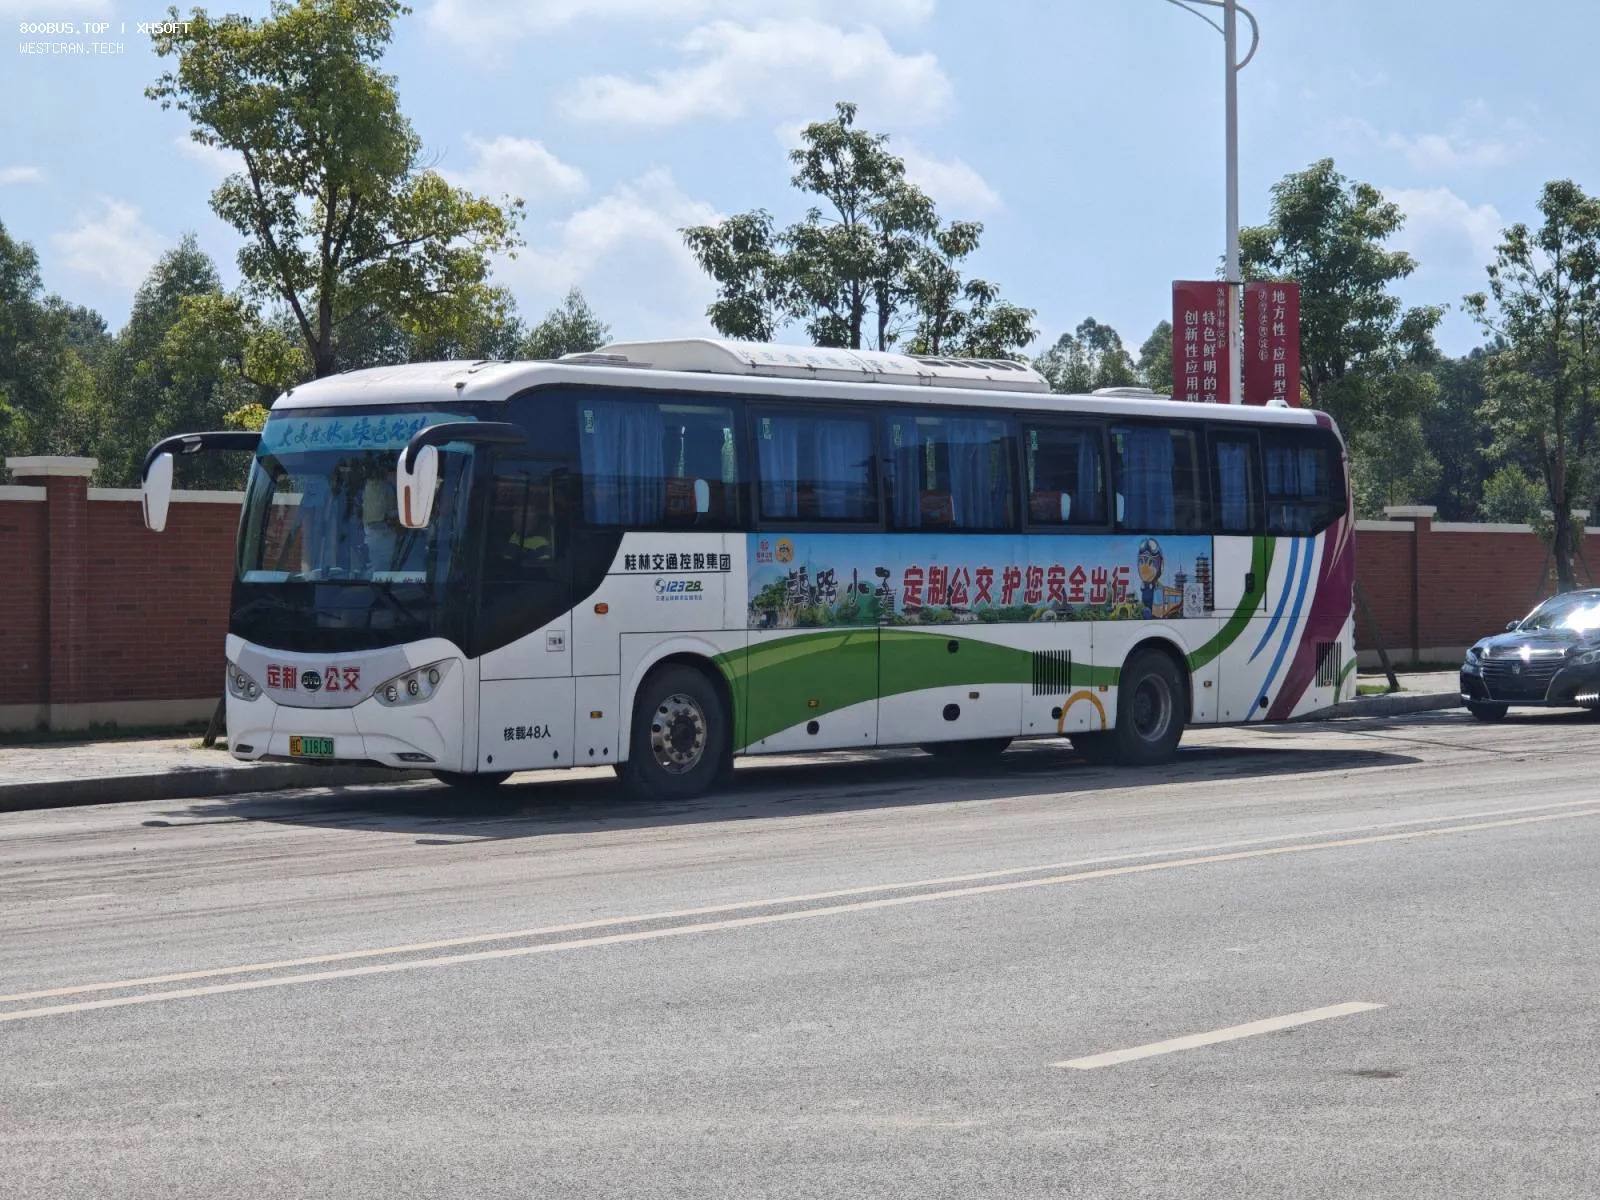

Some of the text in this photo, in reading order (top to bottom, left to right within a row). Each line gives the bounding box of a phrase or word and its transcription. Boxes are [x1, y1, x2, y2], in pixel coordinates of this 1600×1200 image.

[624, 552, 731, 571] 桂林交通控股集团
[665, 580, 704, 593] 12328
[267, 664, 361, 692] 定制 公交
[503, 724, 551, 741] 核载48人
